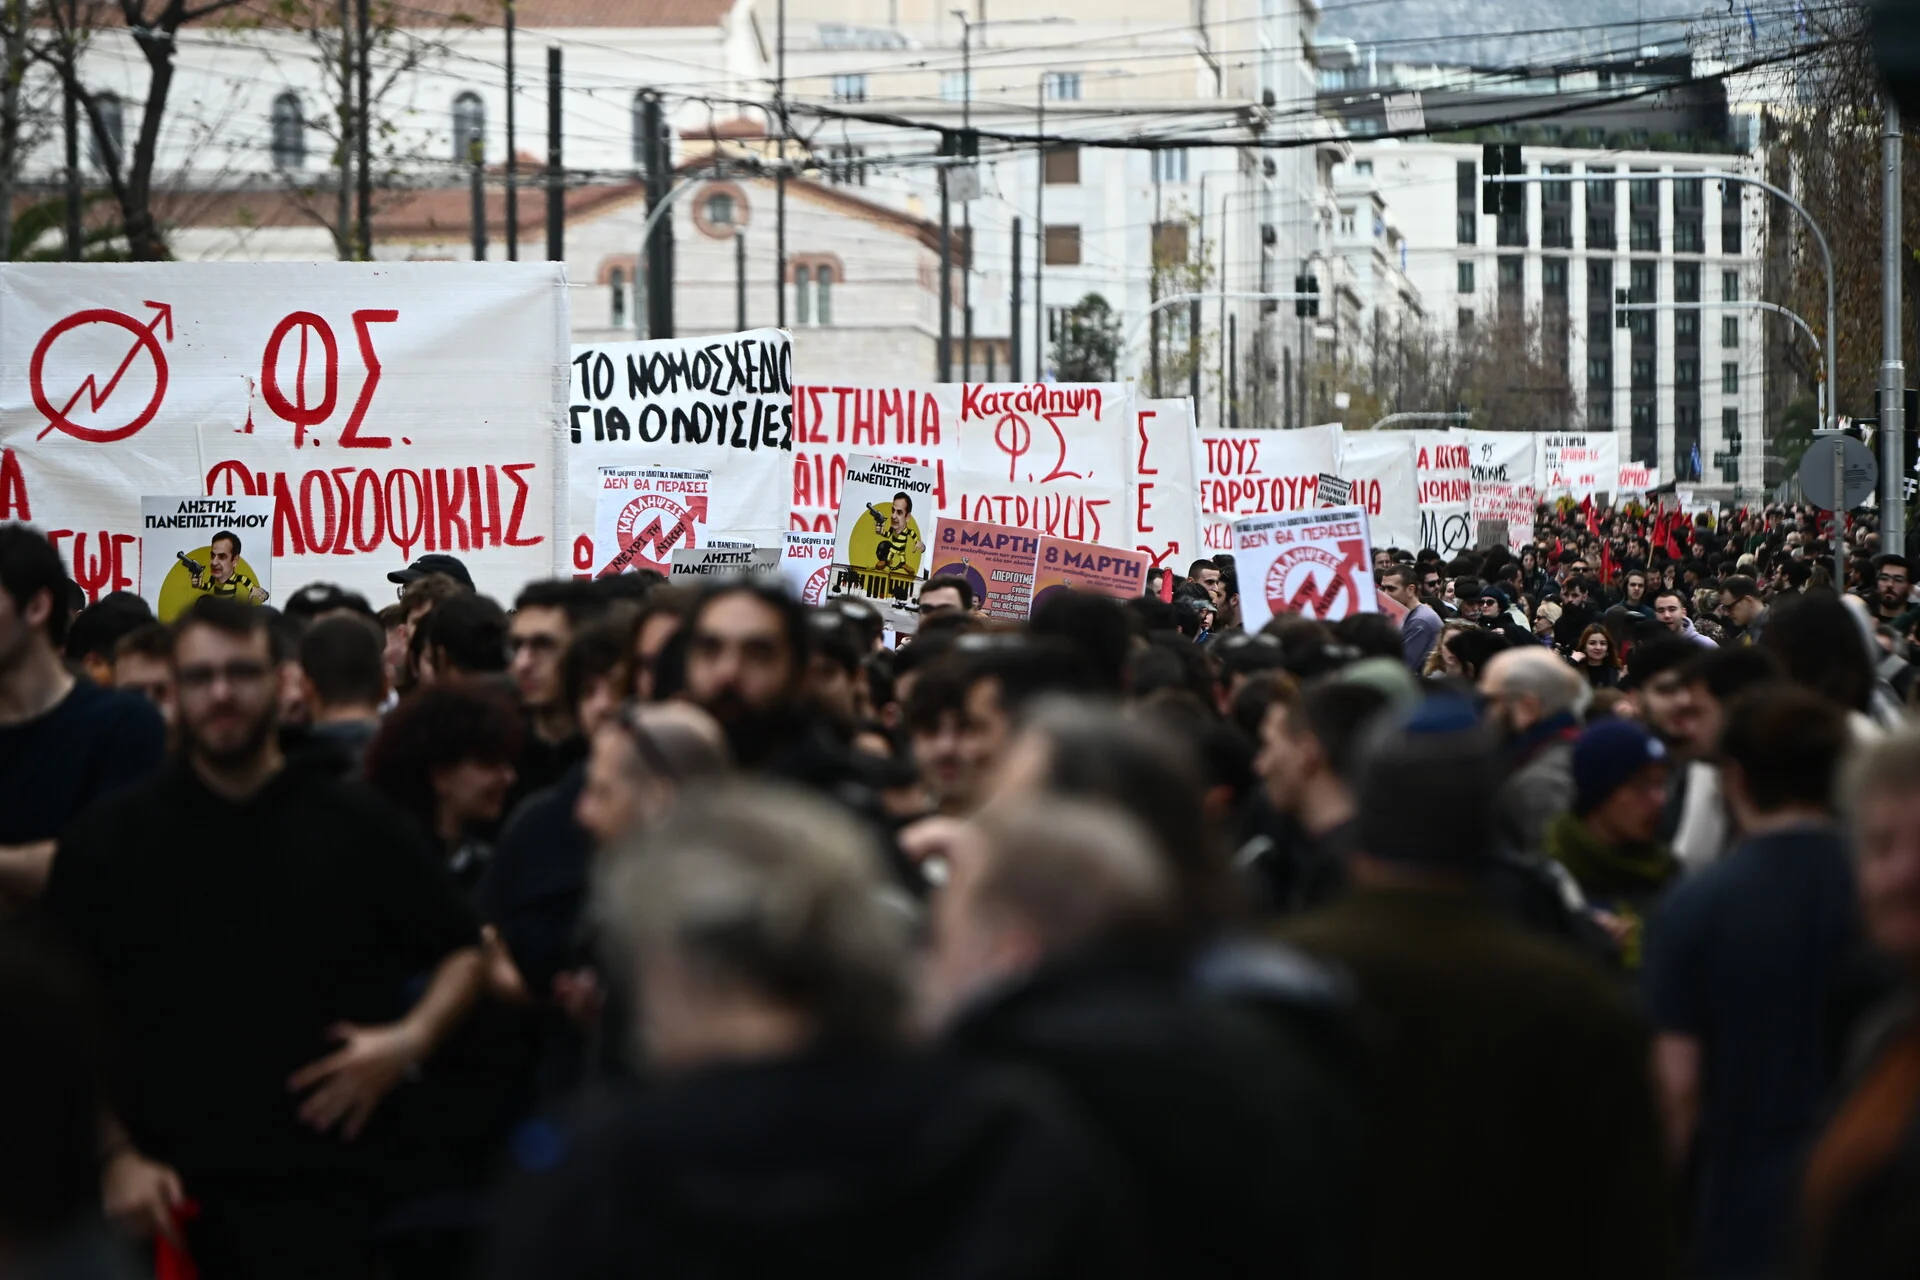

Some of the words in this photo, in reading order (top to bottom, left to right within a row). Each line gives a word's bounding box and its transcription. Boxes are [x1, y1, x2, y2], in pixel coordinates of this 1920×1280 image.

[572, 350, 614, 400] ΤΟ
[792, 385, 941, 446] ΙΣΤΗΜΙΑ
[962, 383, 1102, 422] Κατάληψη
[569, 405, 630, 444] ΓΙΑ
[870, 462, 911, 478] ΛΗΣΤΗΣ
[1203, 438, 1262, 476] ΤΟΥΣ
[604, 477, 628, 489] ΔΕΝ
[634, 479, 650, 491] ΘΑ
[656, 480, 708, 493] ΠΕΡΑΣΕΙ
[847, 470, 931, 493] ΠΑΝΕΠΙΣΤΗΜΙΟΥ
[178, 500, 237, 514] ΛΗΣΤΗΣ
[618, 496, 685, 533] ΚΑΤΑΛΗΨΕΙΣ
[145, 514, 269, 529] ΠΑΝΕΠΙΣΤΗΜΙΟΥ
[612, 536, 648, 571] ΜΕΧΡΙ
[646, 523, 661, 537] ΤΗ
[943, 528, 955, 543] 8
[961, 529, 1039, 554] ΜΑΡΤΗ
[1240, 532, 1268, 549] ΔΕΝ
[1275, 530, 1294, 544] ΘΑ
[1302, 522, 1361, 540] ΠΕΡΑΣΕΙ
[702, 551, 751, 563] ΛΗΣΤΗΣ
[788, 545, 813, 558] ΔΕΝ
[1045, 546, 1058, 563] 8
[1063, 549, 1140, 578] ΜΑΡΤΗ
[672, 562, 776, 575] ΠΑΝΕΠΙΣΤΗΜΙΟΥ
[991, 570, 1033, 585] ΑΠΕΡΓΟΥΜΕ
